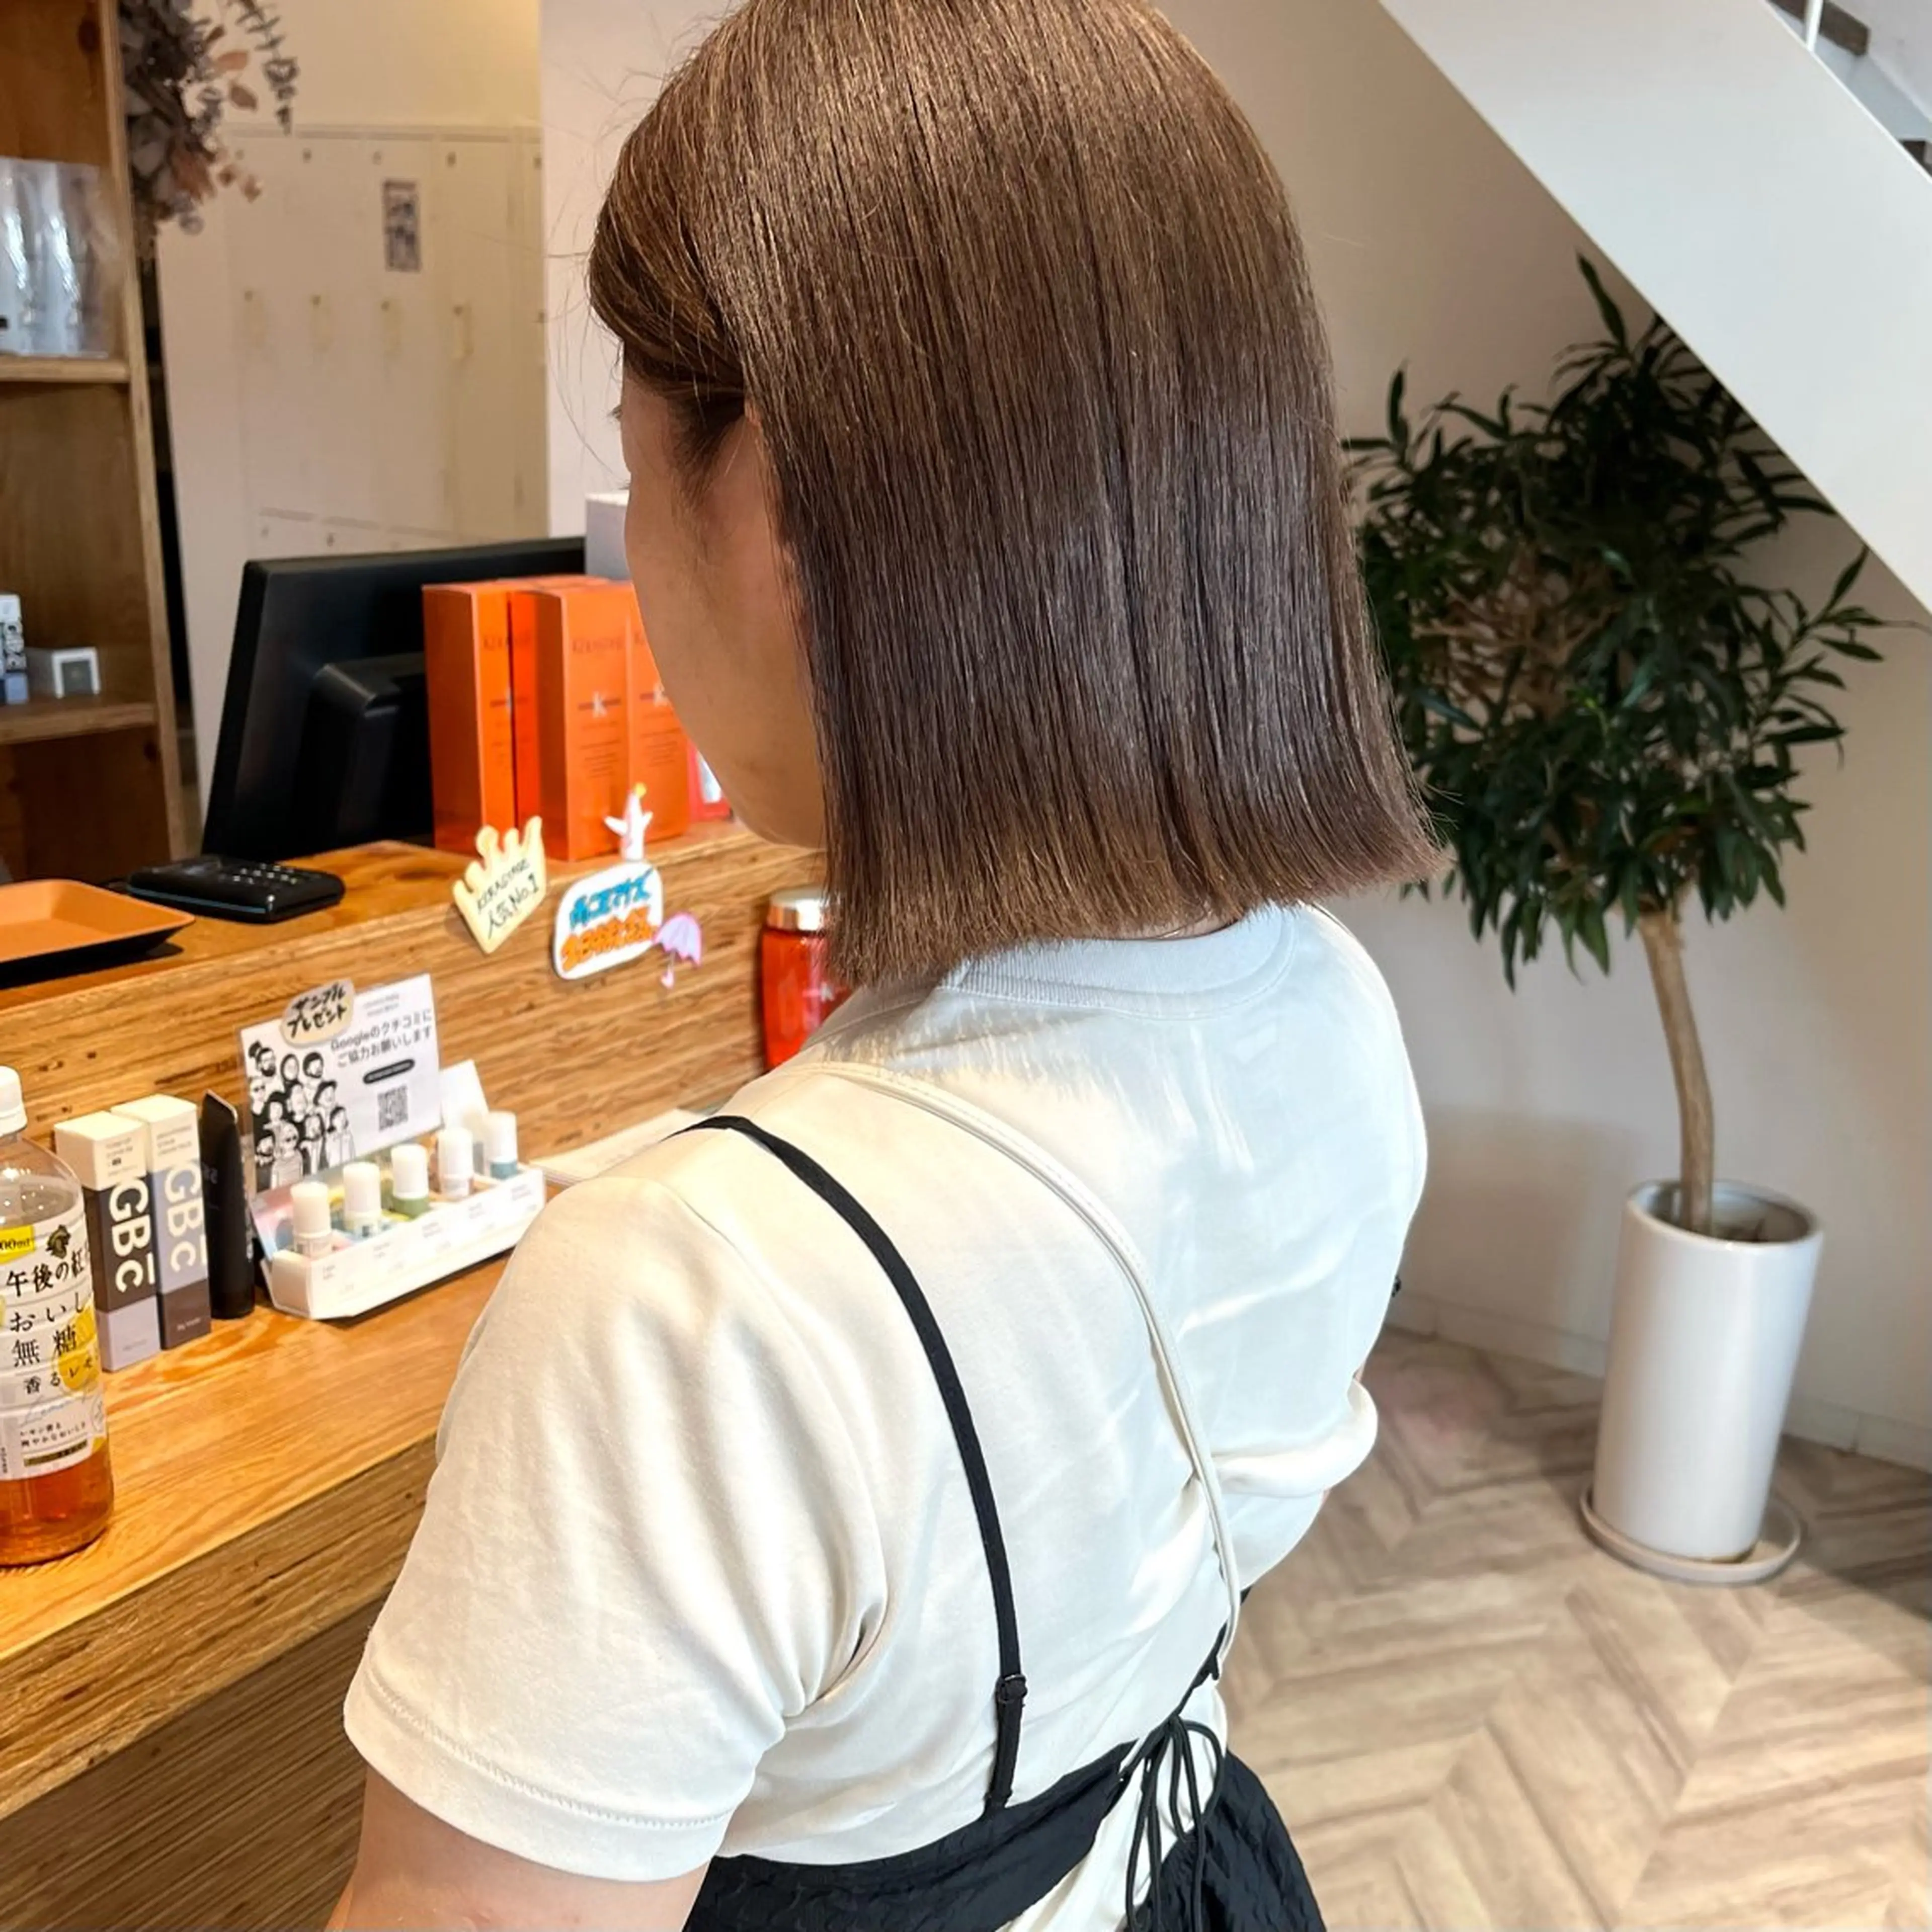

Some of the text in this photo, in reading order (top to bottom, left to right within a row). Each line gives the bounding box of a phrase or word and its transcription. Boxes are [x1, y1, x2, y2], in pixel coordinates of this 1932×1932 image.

[287, 1003, 347, 1039] プレゼント
[6, 1247, 87, 1297] 午後の紅
